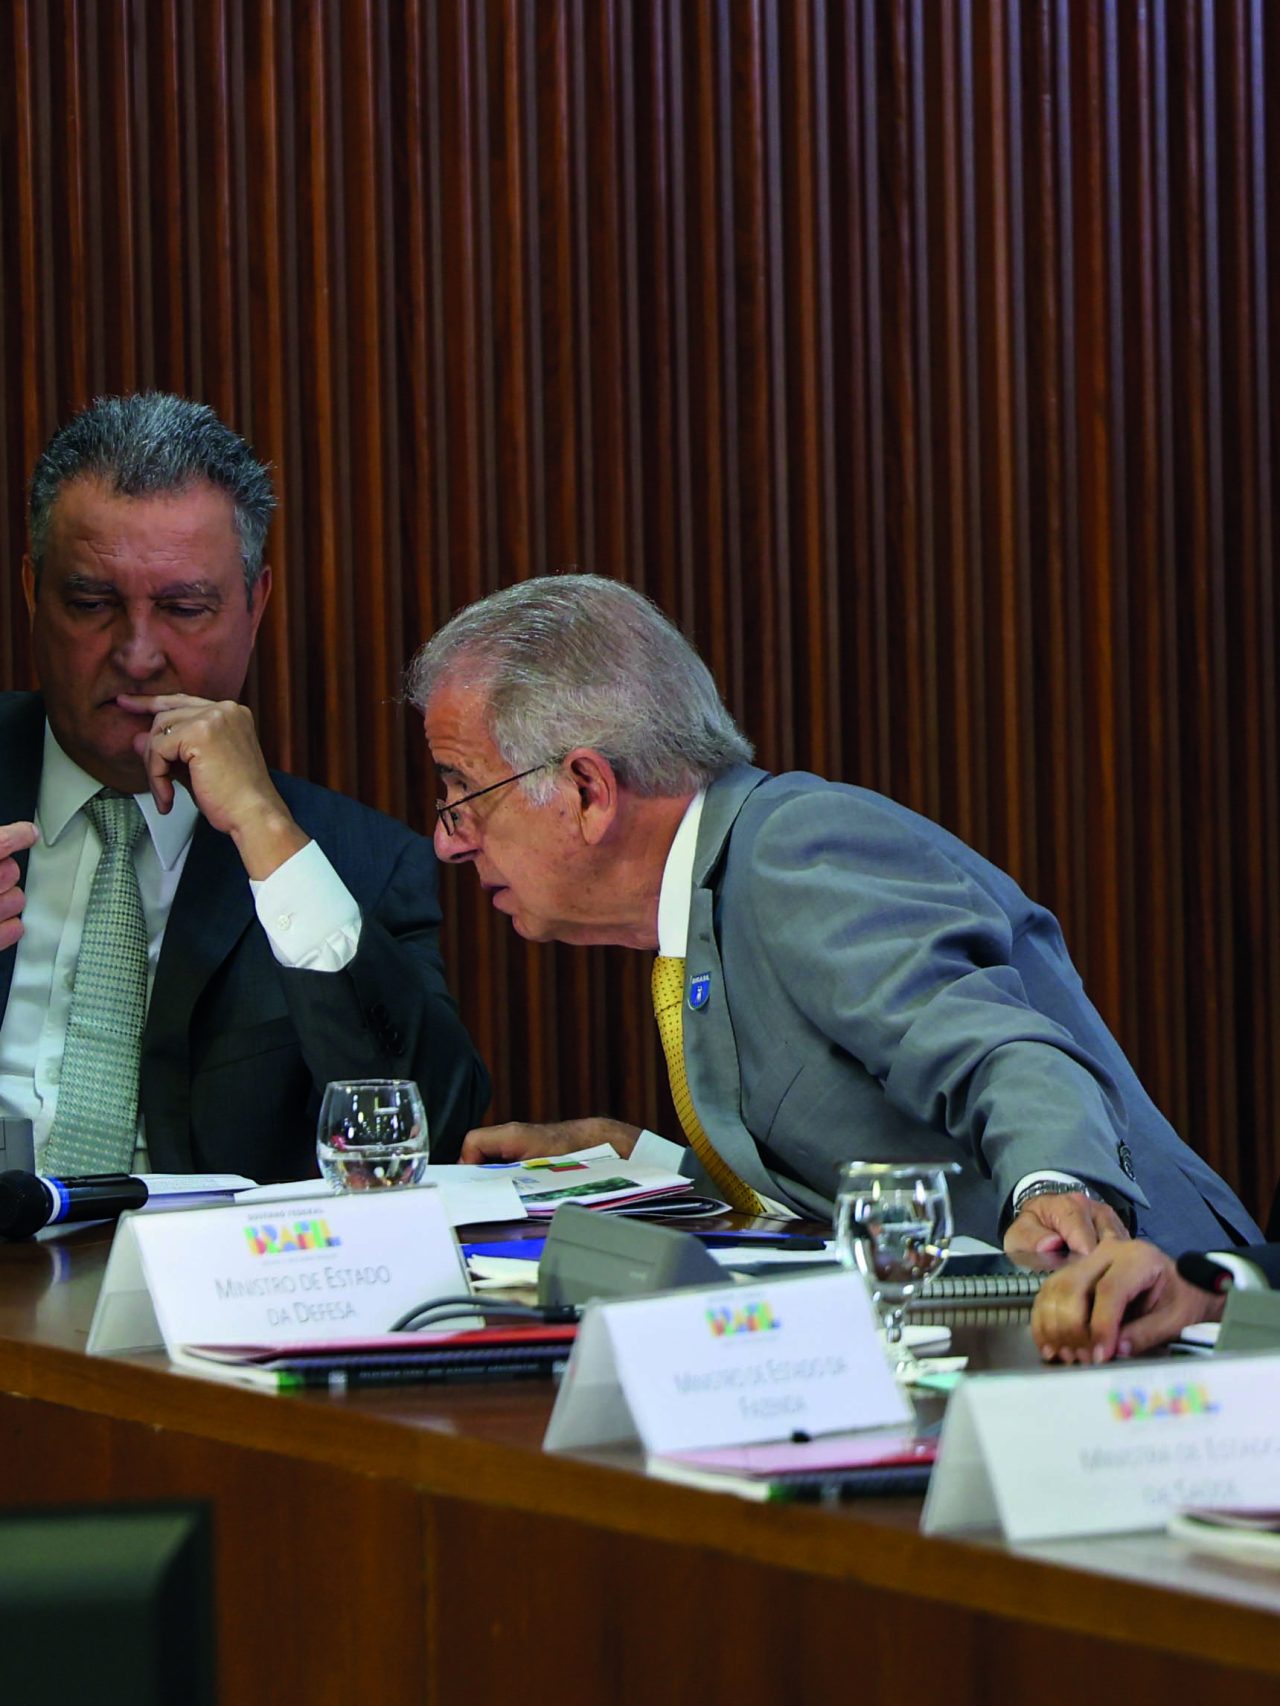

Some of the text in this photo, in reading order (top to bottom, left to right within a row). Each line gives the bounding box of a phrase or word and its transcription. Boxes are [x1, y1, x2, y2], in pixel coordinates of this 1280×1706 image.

[243, 1218, 342, 1257] BRASIL
[214, 1264, 391, 1299] MINISTRO DE ESTADO
[266, 1300, 357, 1327] DA DEFESA
[704, 1299, 782, 1338] BRASIL
